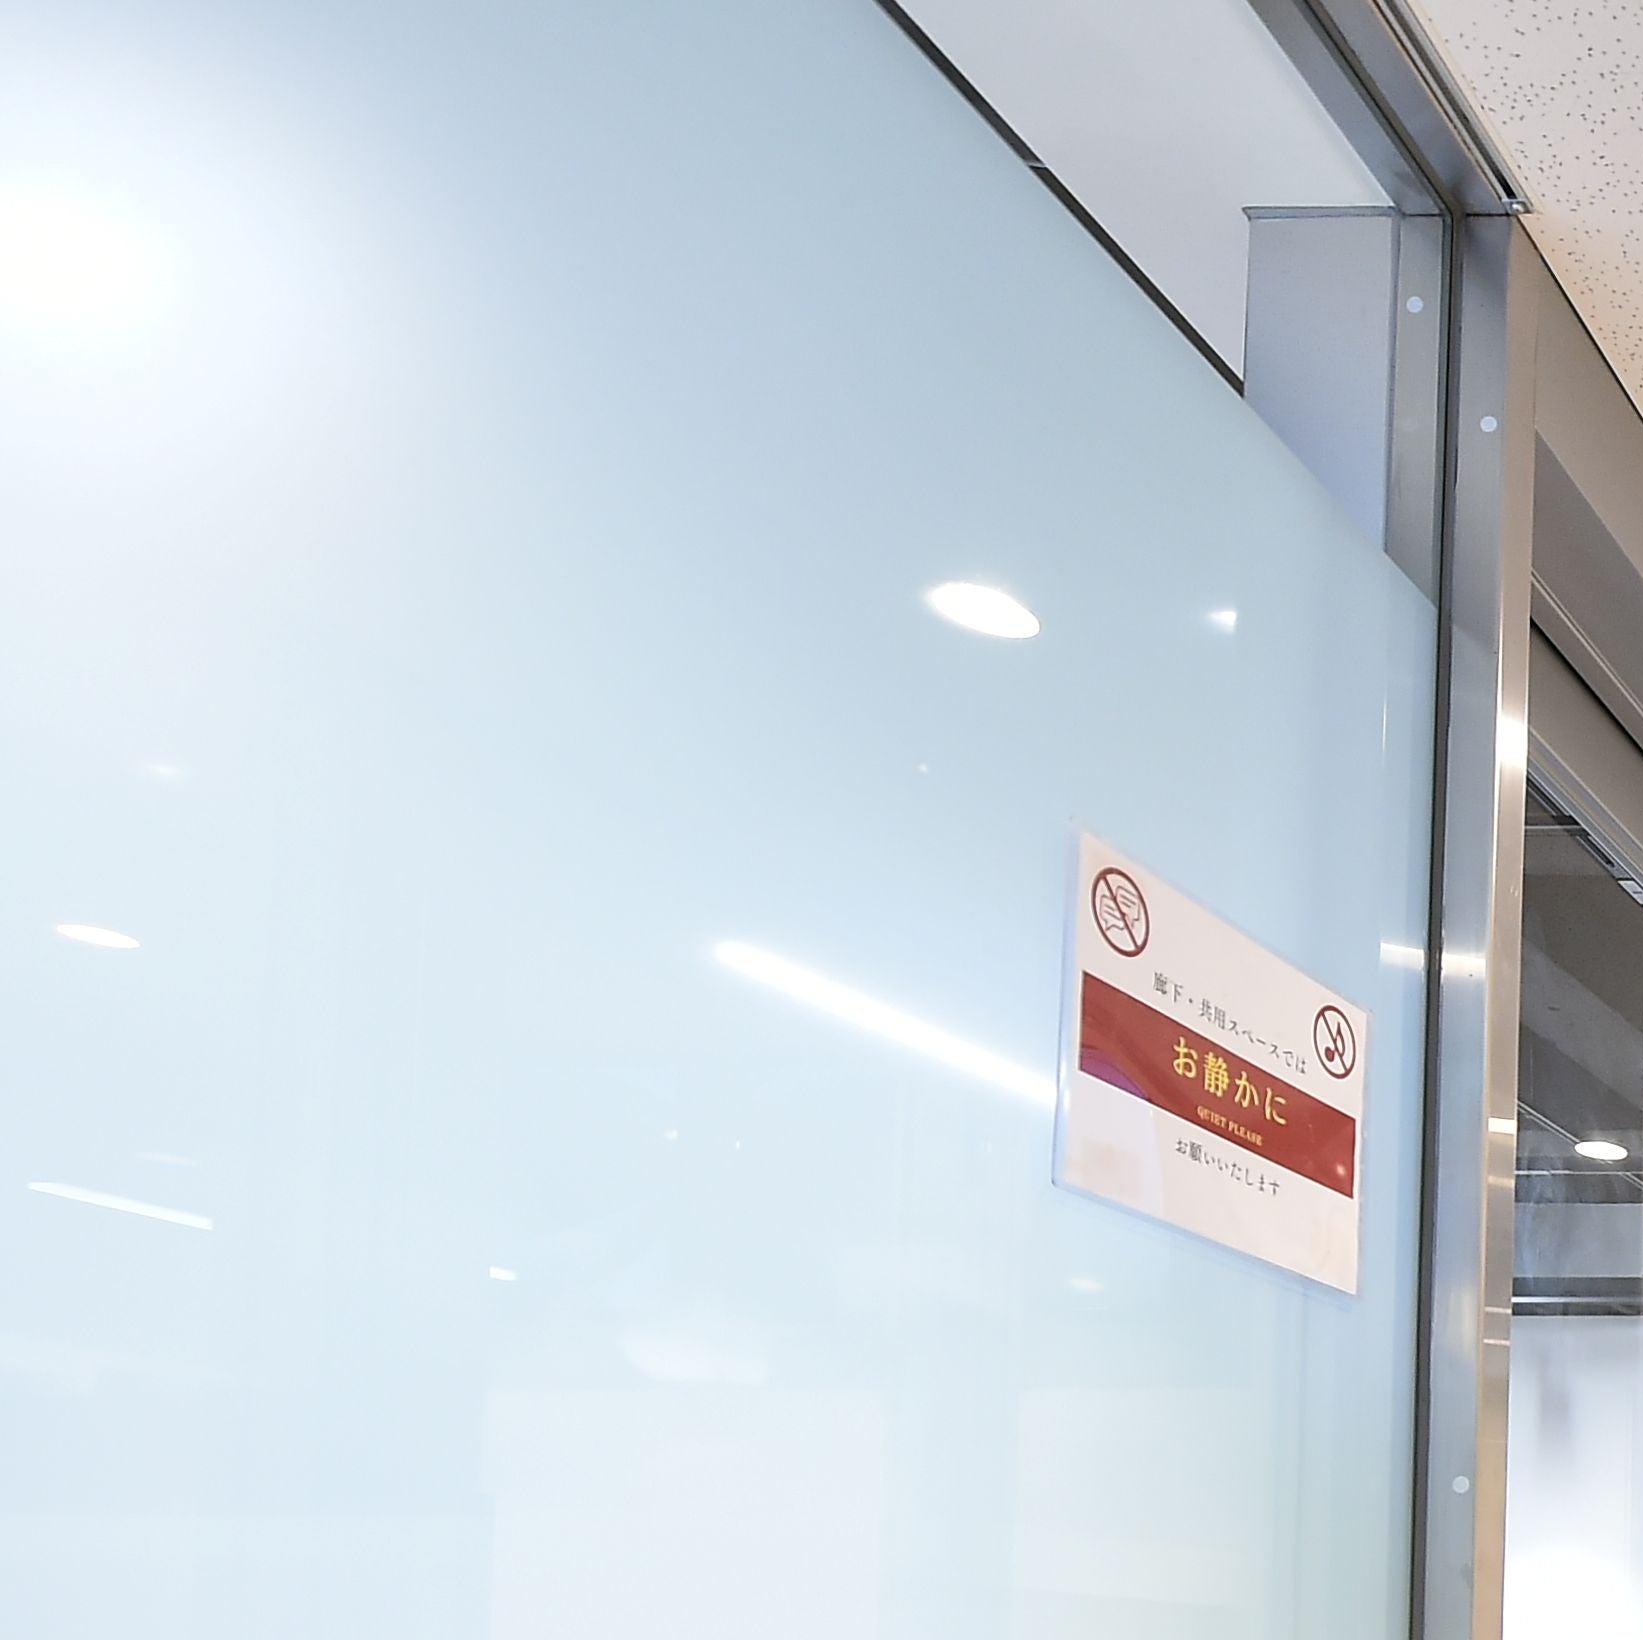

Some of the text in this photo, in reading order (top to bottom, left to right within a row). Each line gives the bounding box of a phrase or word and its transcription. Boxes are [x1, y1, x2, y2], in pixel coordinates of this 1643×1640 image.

[1153, 971, 1307, 1074] 廊下・共用スペースでは
[1173, 1036, 1288, 1125] お静かに
[1197, 1105, 1263, 1146] QUIET PLEASE
[1175, 1138, 1280, 1195] お願いいたします
